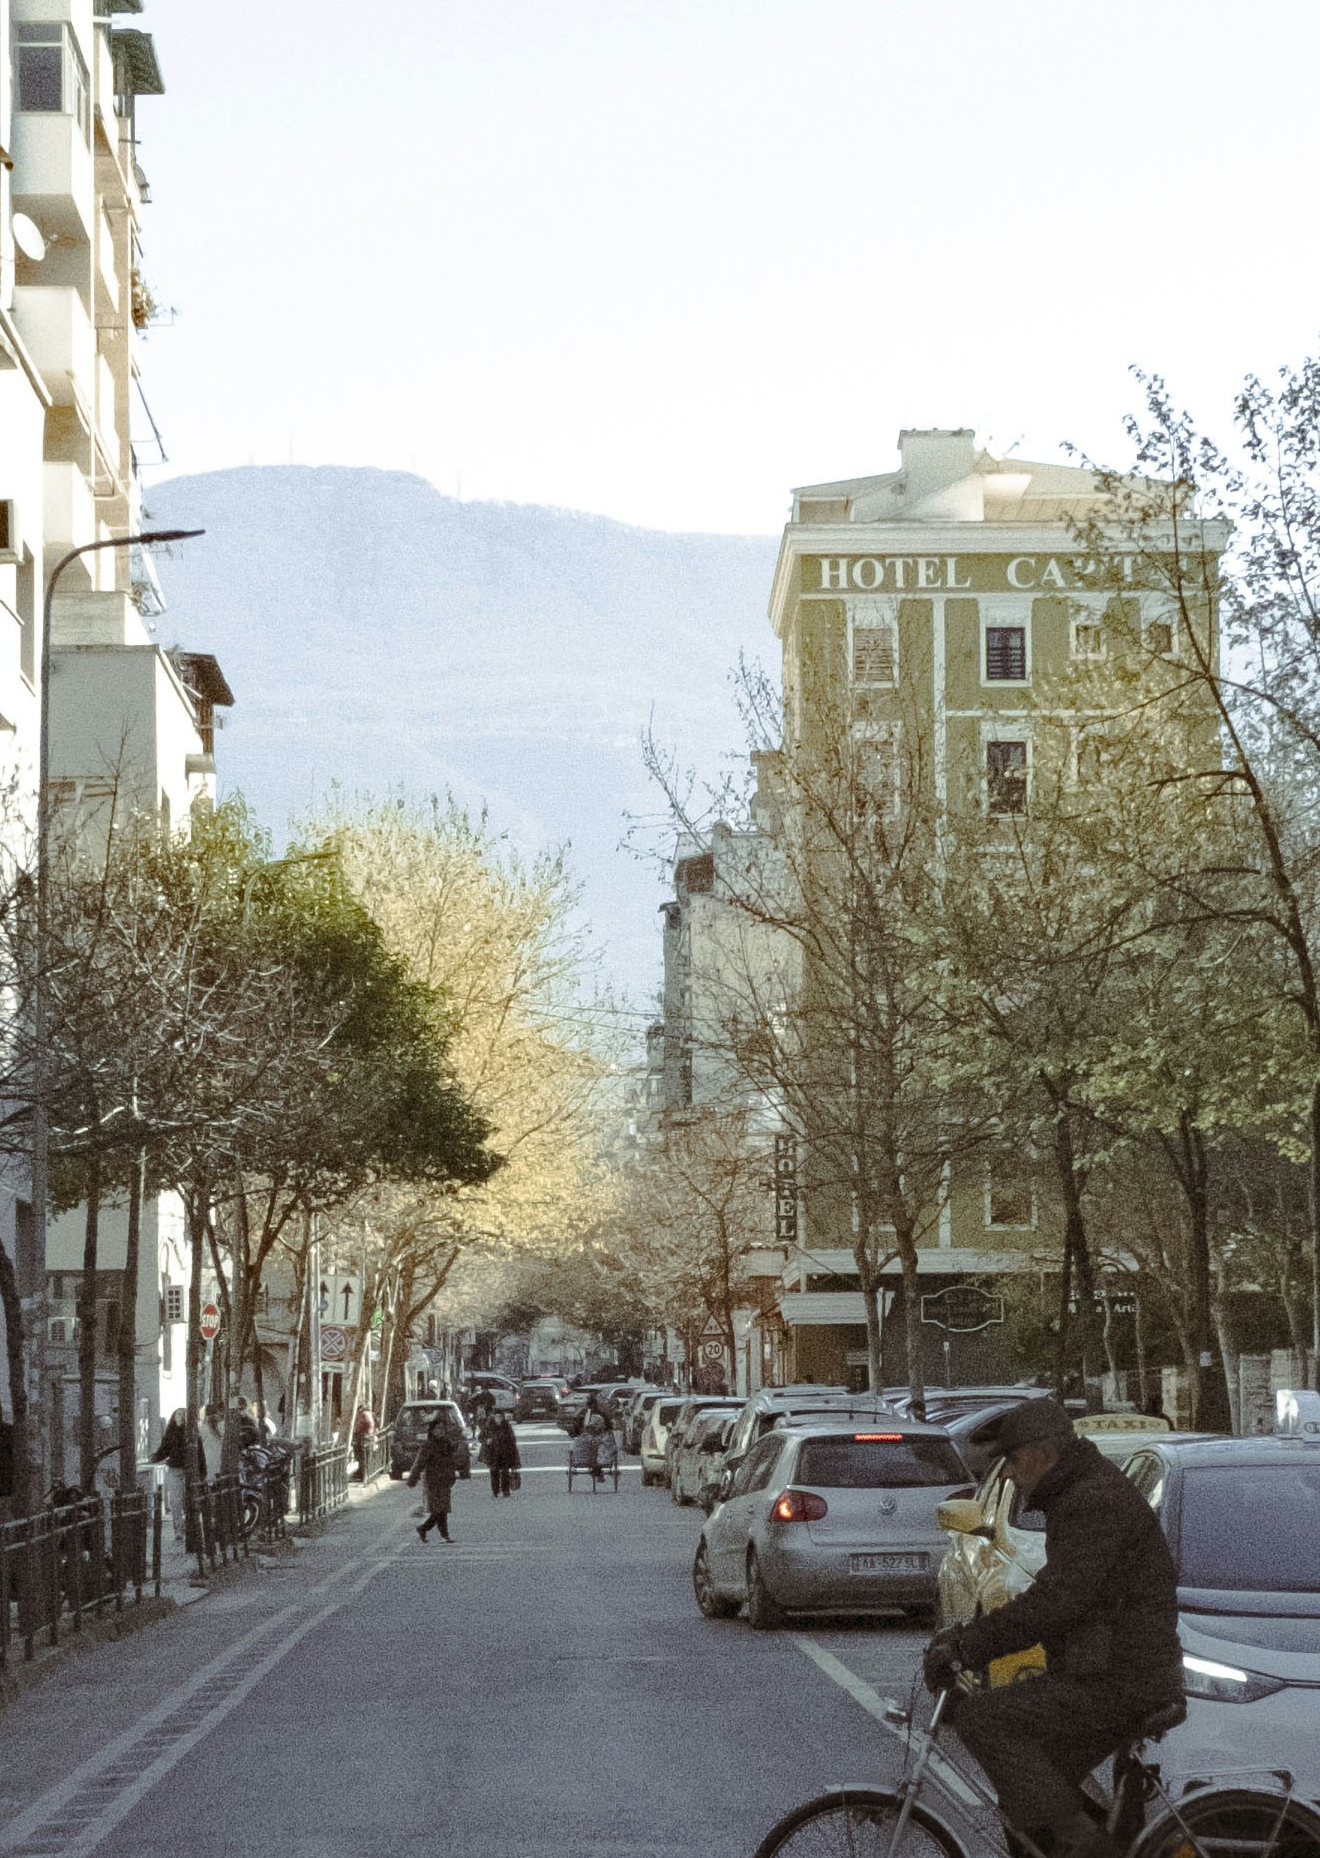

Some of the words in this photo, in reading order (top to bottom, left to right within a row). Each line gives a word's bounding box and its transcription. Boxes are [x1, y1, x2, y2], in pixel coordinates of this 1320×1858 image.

[819, 557, 971, 589] HOTEL
[201, 1314, 220, 1329] STOP
[708, 1344, 721, 1356] 20
[1092, 1419, 1147, 1430] TAXI
